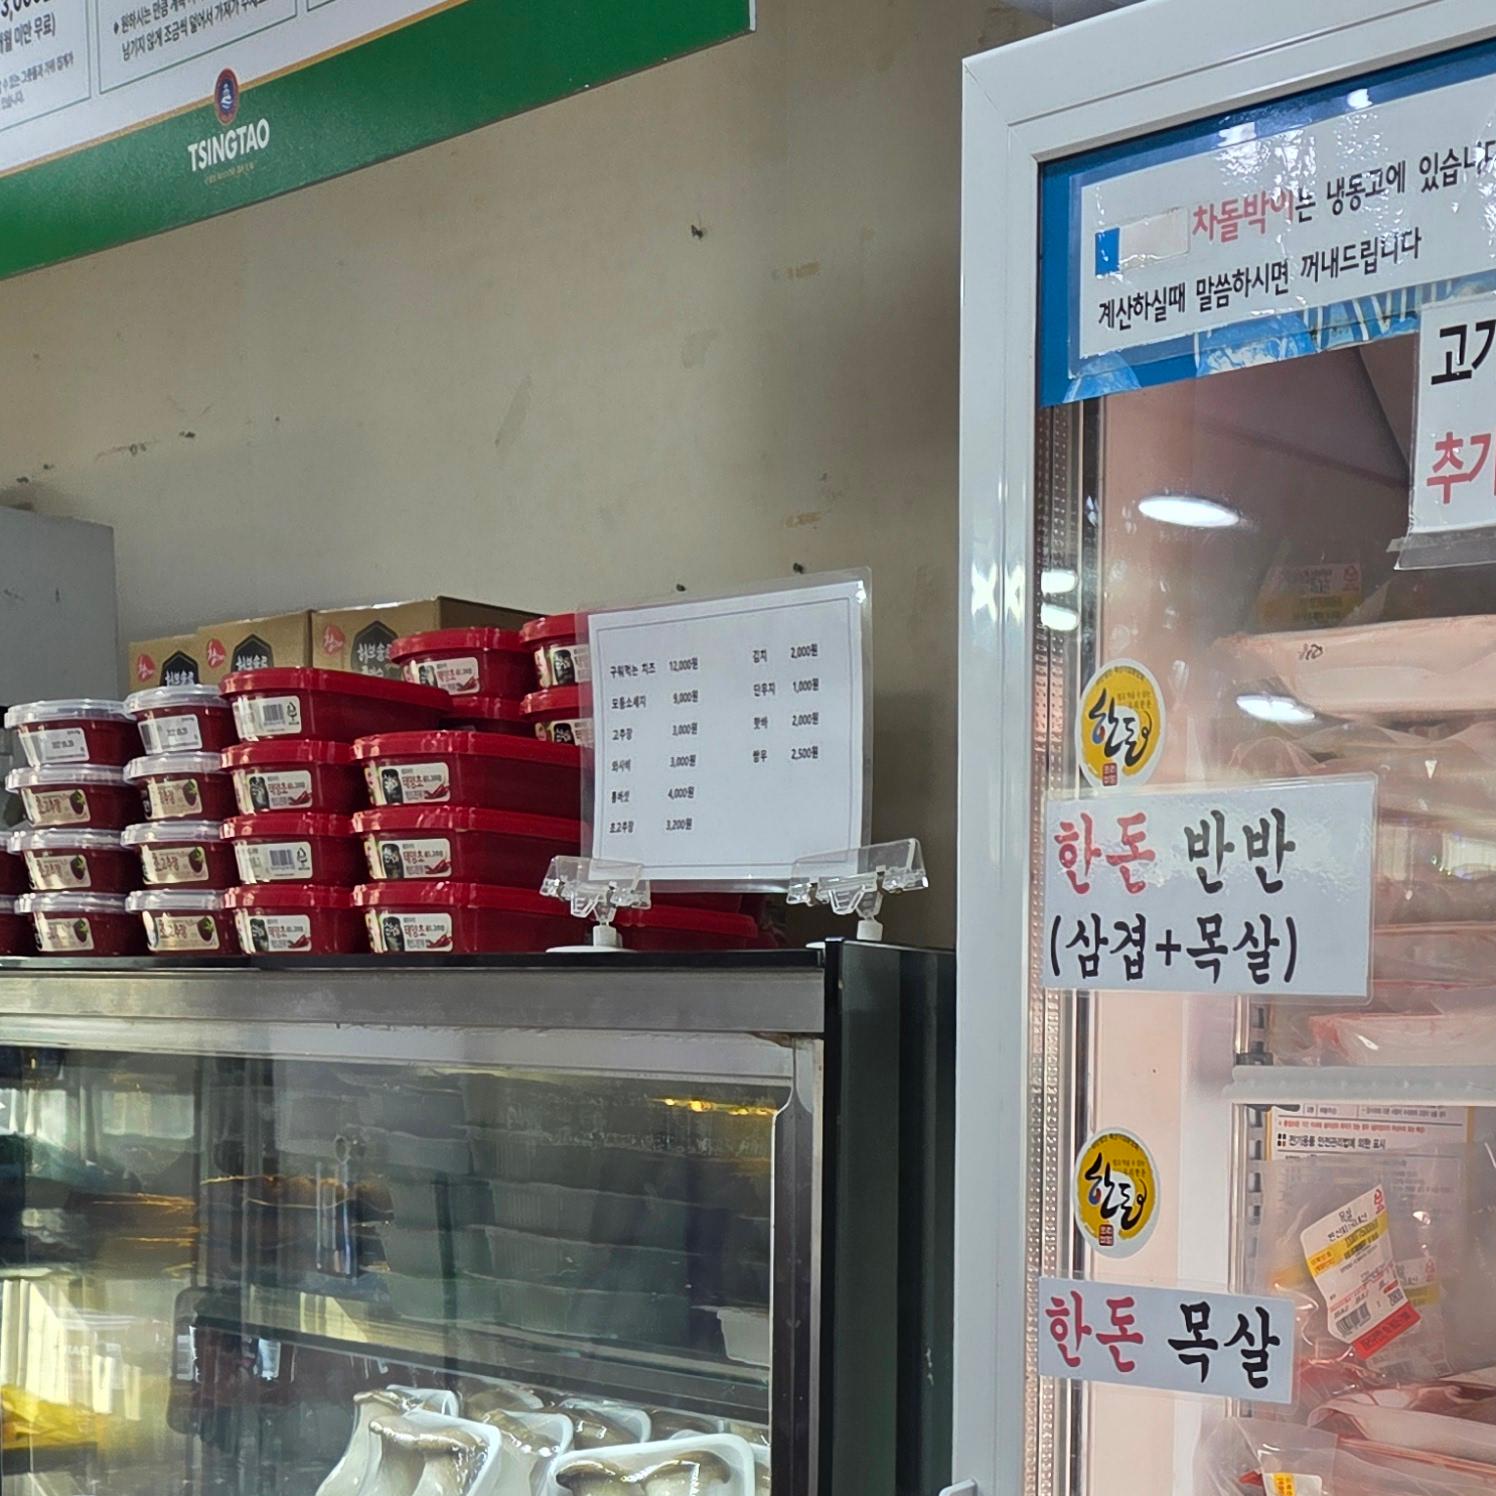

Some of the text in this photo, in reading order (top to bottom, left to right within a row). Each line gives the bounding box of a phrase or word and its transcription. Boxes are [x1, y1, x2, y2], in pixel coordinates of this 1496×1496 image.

[187, 118, 270, 172] TSINGTAO
[1327, 161, 1406, 215] 냉동고에
[1098, 227, 1421, 331] 계산하실때 말씀하시면 꺼내드립니다
[1054, 807, 1296, 894] 한돈 반반
[1050, 912, 1297, 985] (삼겹+목살)
[1045, 1290, 1144, 1373] 한돈
[1167, 1301, 1280, 1390] 목살
